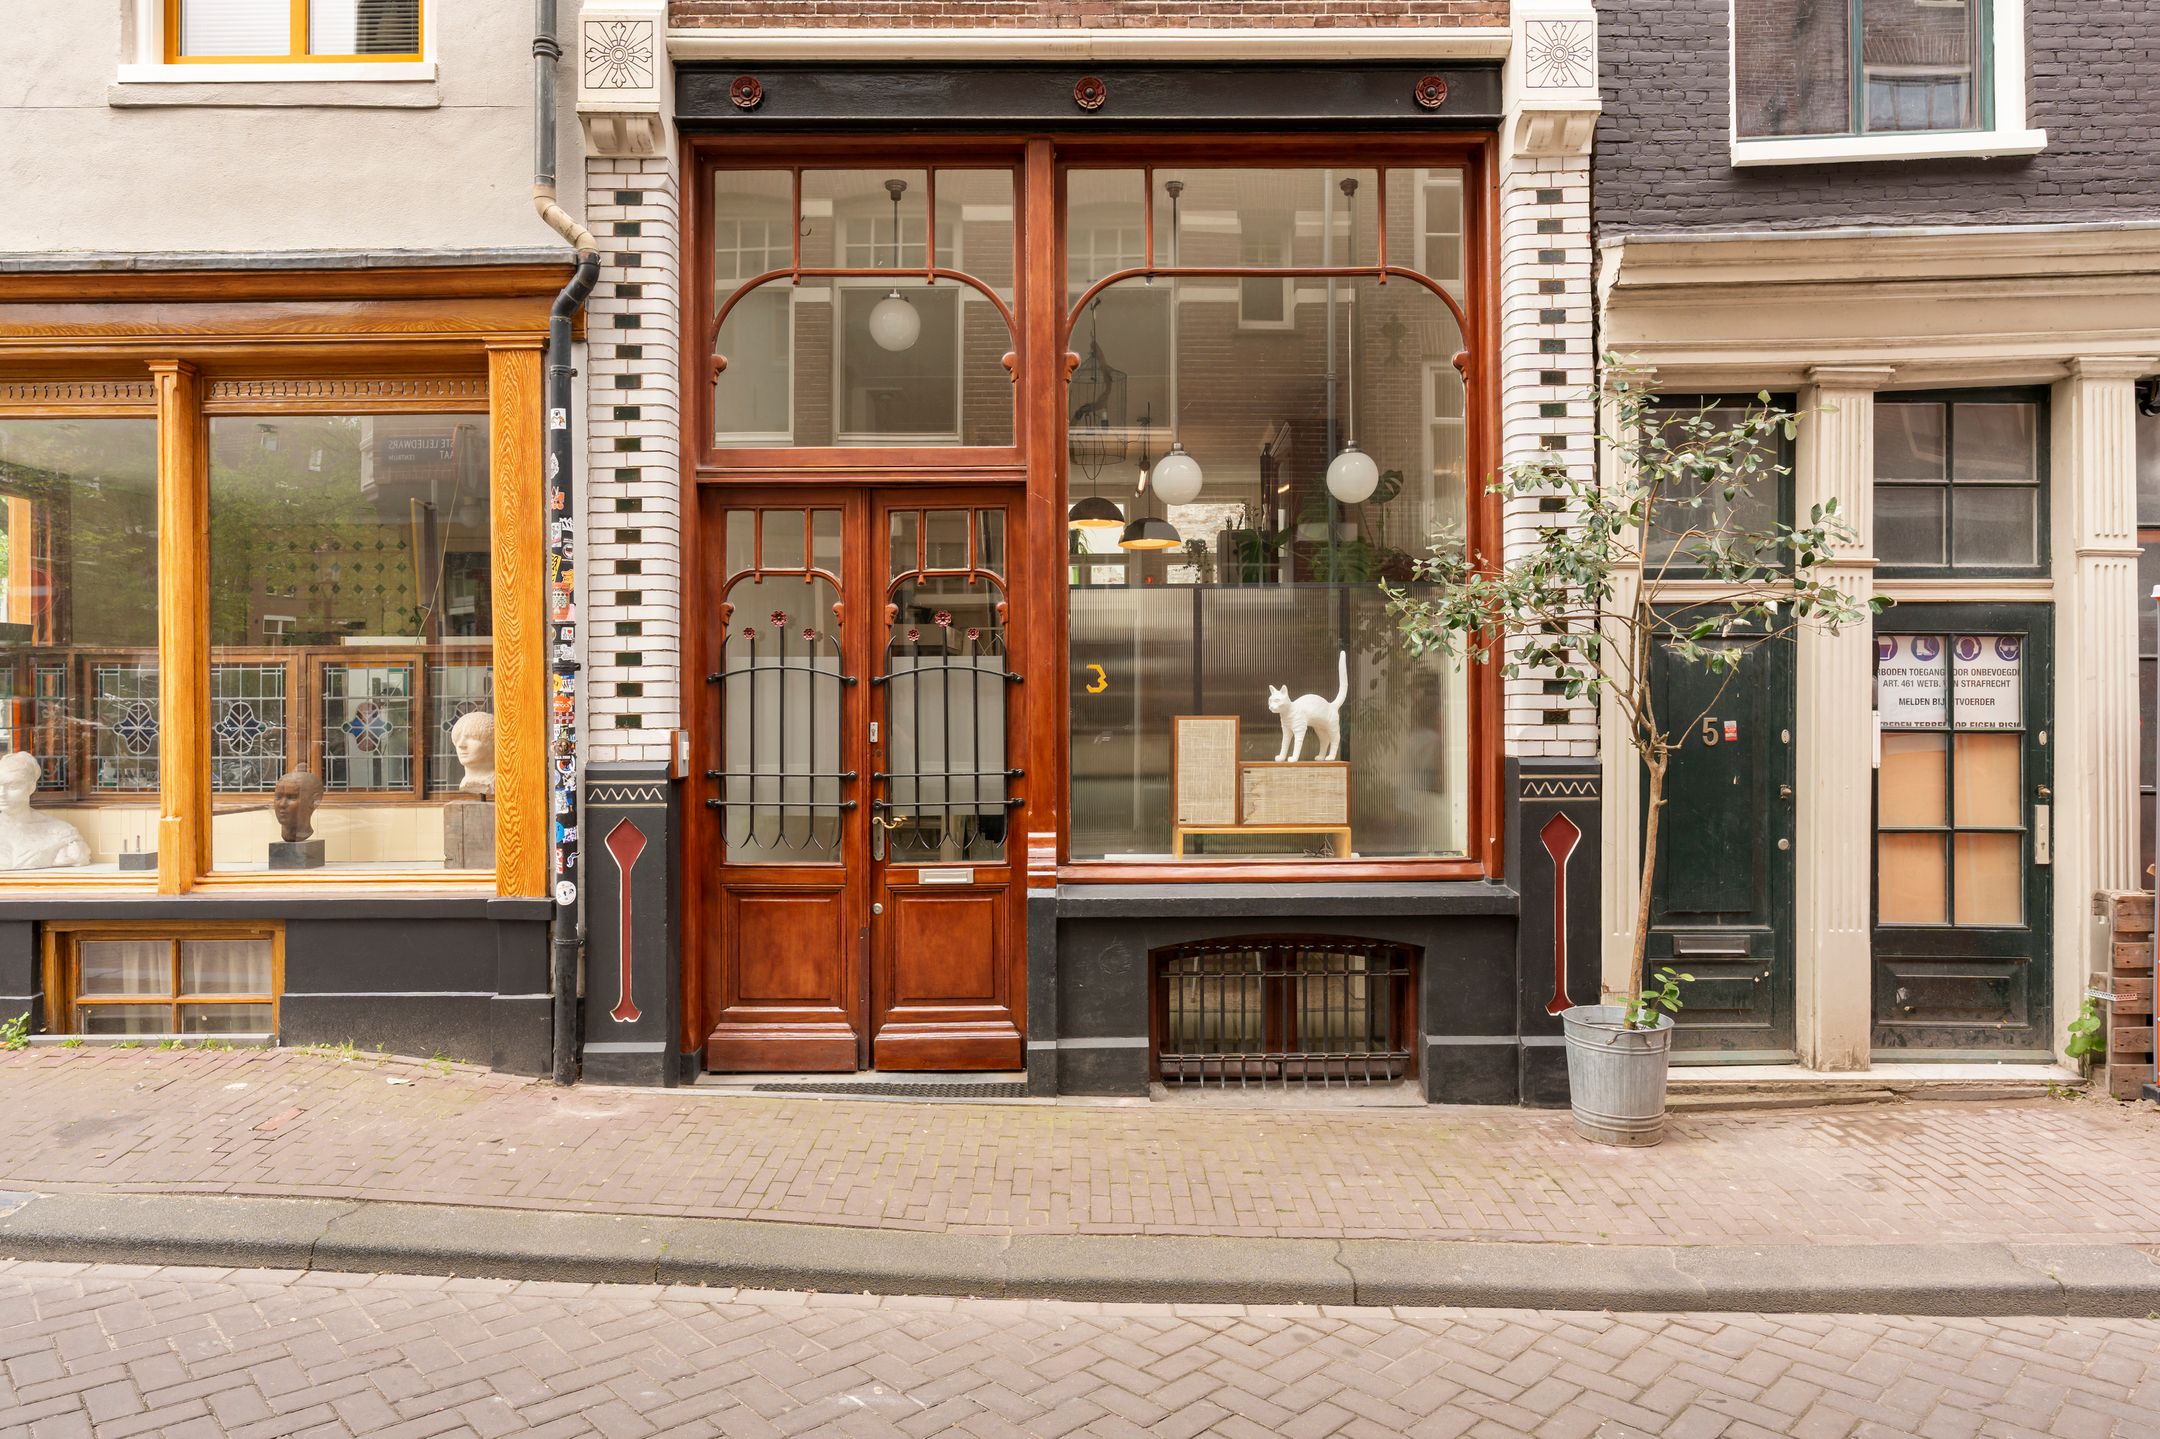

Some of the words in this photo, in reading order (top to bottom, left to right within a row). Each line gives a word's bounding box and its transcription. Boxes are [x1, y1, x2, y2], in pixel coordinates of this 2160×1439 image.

[1086, 664, 1108, 693] 3
[1909, 668, 1945, 676] TOEGANG
[1702, 717, 1719, 746] 5
